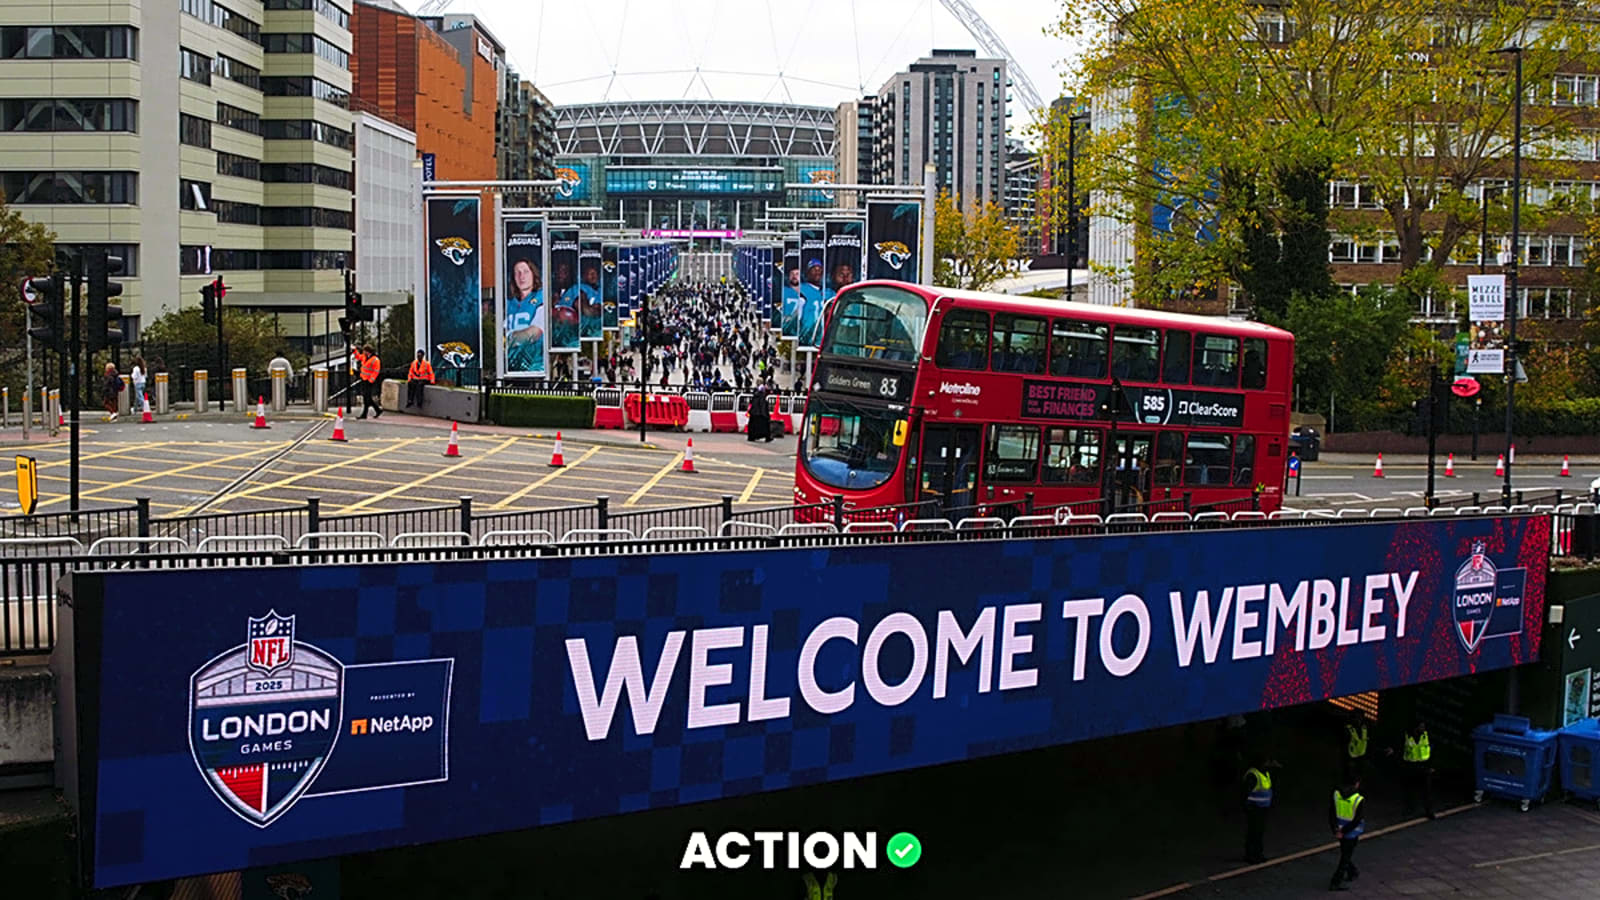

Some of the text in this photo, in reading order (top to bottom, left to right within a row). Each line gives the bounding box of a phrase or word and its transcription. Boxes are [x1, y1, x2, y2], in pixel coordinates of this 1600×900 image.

[507, 238, 541, 247] JAGUARS
[827, 238, 861, 248] JAGUARS
[1472, 285, 1501, 294] MEZZE
[1472, 294, 1502, 303] GRILL
[828, 374, 898, 396] Golders Green 83
[939, 381, 981, 396] Metroline
[1028, 385, 1097, 402] BEST FRIEND
[1042, 401, 1095, 416] FINANCES
[1143, 395, 1165, 411] 585
[1188, 401, 1238, 417] ClearScore
[1457, 592, 1493, 608] LONDON
[252, 638, 289, 667] NFL
[565, 570, 1420, 741] WELCOME TO WEMBLEY
[255, 681, 283, 691] 2025
[202, 708, 330, 741] LONDON
[370, 715, 433, 734] NetApp
[240, 740, 293, 754] GAMES
